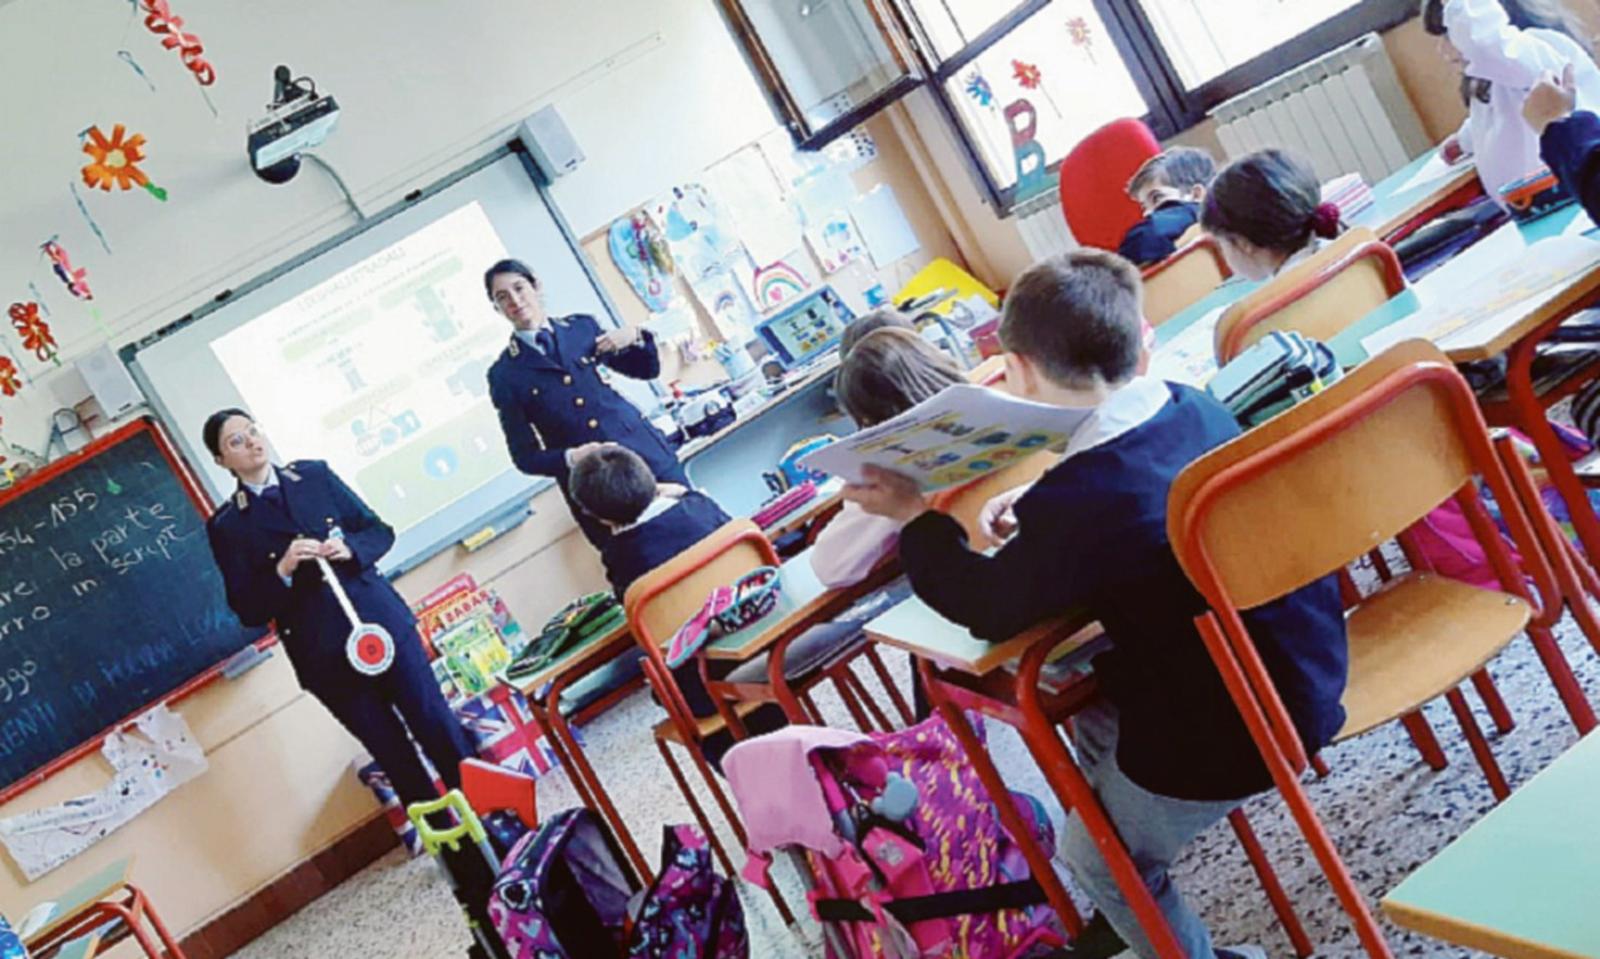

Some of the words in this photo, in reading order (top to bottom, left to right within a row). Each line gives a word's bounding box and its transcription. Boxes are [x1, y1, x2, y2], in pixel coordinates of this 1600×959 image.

[49, 545, 84, 571] la
[91, 502, 175, 563] parte
[72, 578, 98, 597] in
